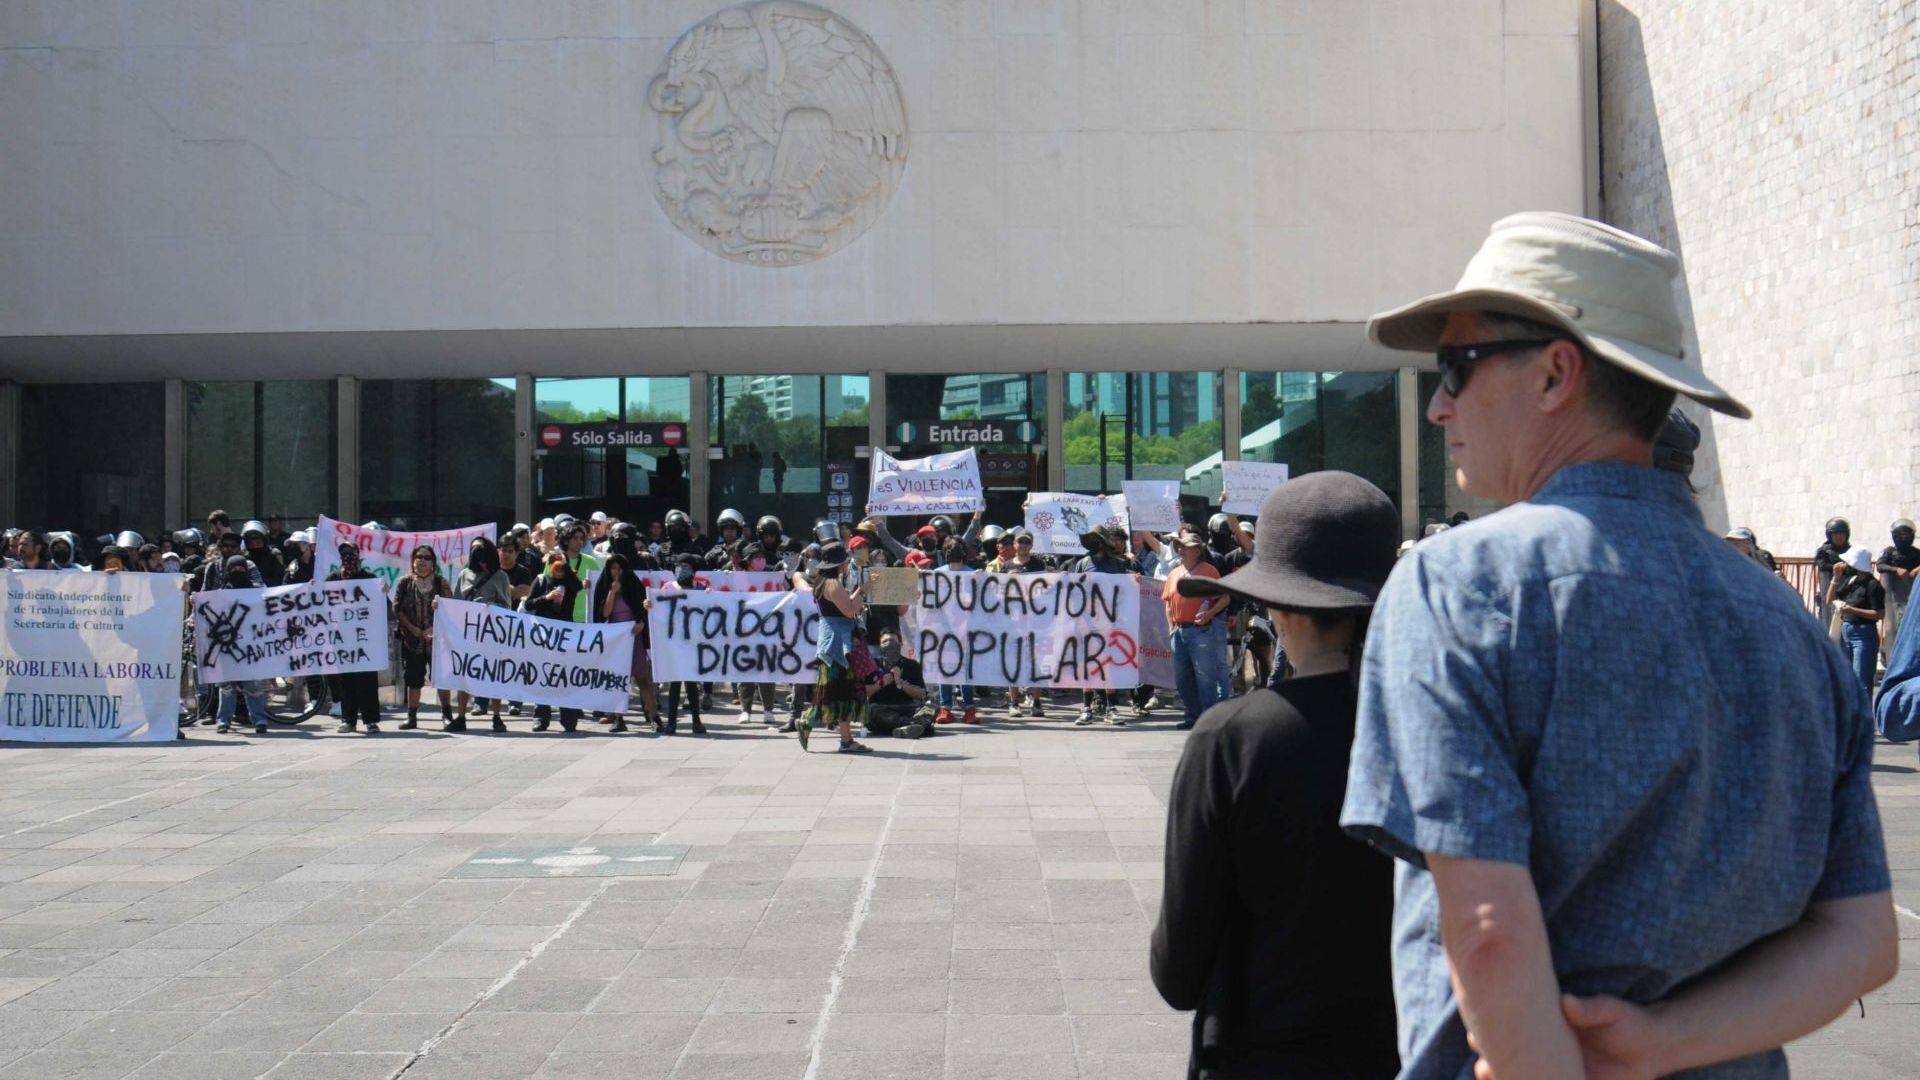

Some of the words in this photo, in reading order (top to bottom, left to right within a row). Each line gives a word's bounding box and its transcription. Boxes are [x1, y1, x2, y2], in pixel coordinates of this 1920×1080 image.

[572, 430, 604, 445] Sólo
[607, 430, 652, 445] Salida
[929, 424, 1003, 443] Entrada
[897, 478, 976, 493] VIOLENCIA
[906, 503, 921, 511] LA
[8, 590, 56, 601] Sindicato
[59, 591, 133, 604] Independiente
[265, 586, 370, 615] ESCUELA
[921, 572, 1119, 623] EDUCACIÓN
[14, 606, 24, 615] de
[31, 606, 98, 618] Trabajadores
[100, 607, 112, 616] de
[115, 607, 124, 616] la
[656, 594, 819, 648] Trabajo
[69, 620, 81, 630] de
[84, 620, 124, 631] Cultura
[252, 611, 338, 640] NACIONAL
[344, 608, 369, 621] DE
[356, 628, 368, 641] E
[464, 611, 525, 649] HASTA
[530, 622, 573, 652] QUE
[576, 630, 604, 654] LA
[290, 648, 371, 671] HISTORIA
[697, 642, 802, 675] DIGNO
[919, 628, 1106, 683] POPULAR
[0, 659, 89, 678] PROBLEMA
[94, 662, 176, 679] LABORAL
[450, 650, 538, 686] DIGNIDAD
[540, 662, 567, 688] SEA
[569, 665, 629, 692] COSTUMBRE
[5, 692, 26, 727] TE
[32, 693, 122, 729] DEFIENDE
